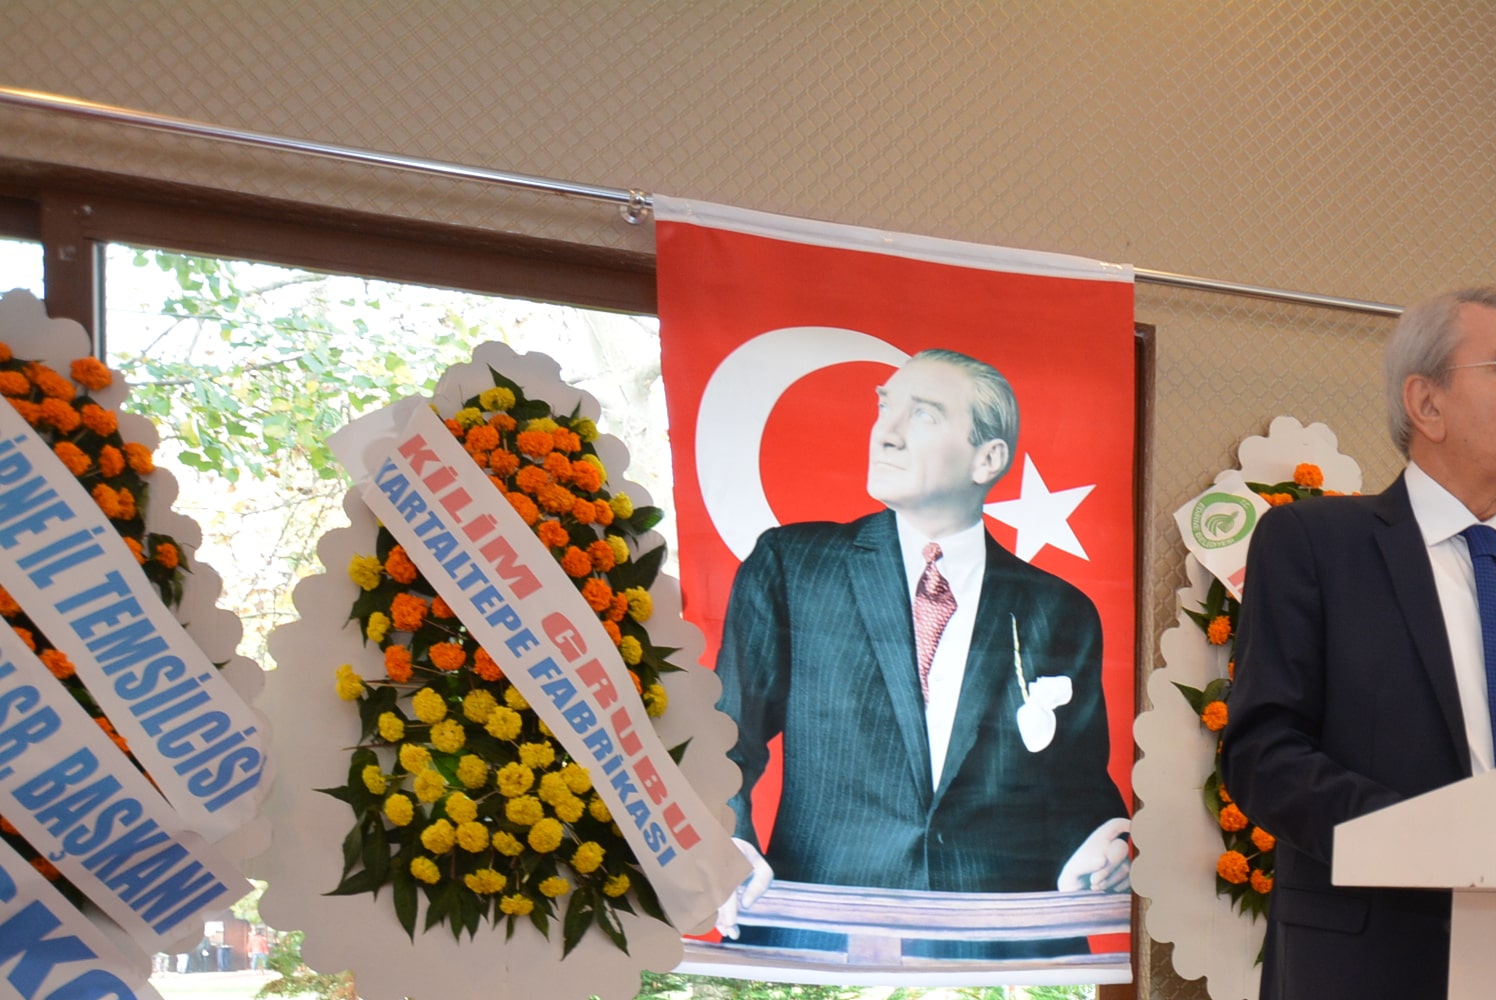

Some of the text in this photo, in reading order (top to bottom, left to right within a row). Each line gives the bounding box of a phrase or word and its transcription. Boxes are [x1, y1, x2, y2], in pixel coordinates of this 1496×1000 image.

[0, 434, 76, 550] NE
[16, 525, 106, 590] İL
[398, 434, 702, 850] KİLİM GRUBU
[11, 747, 228, 936] BAŞKANI
[527, 657, 676, 868] FABRİKASI
